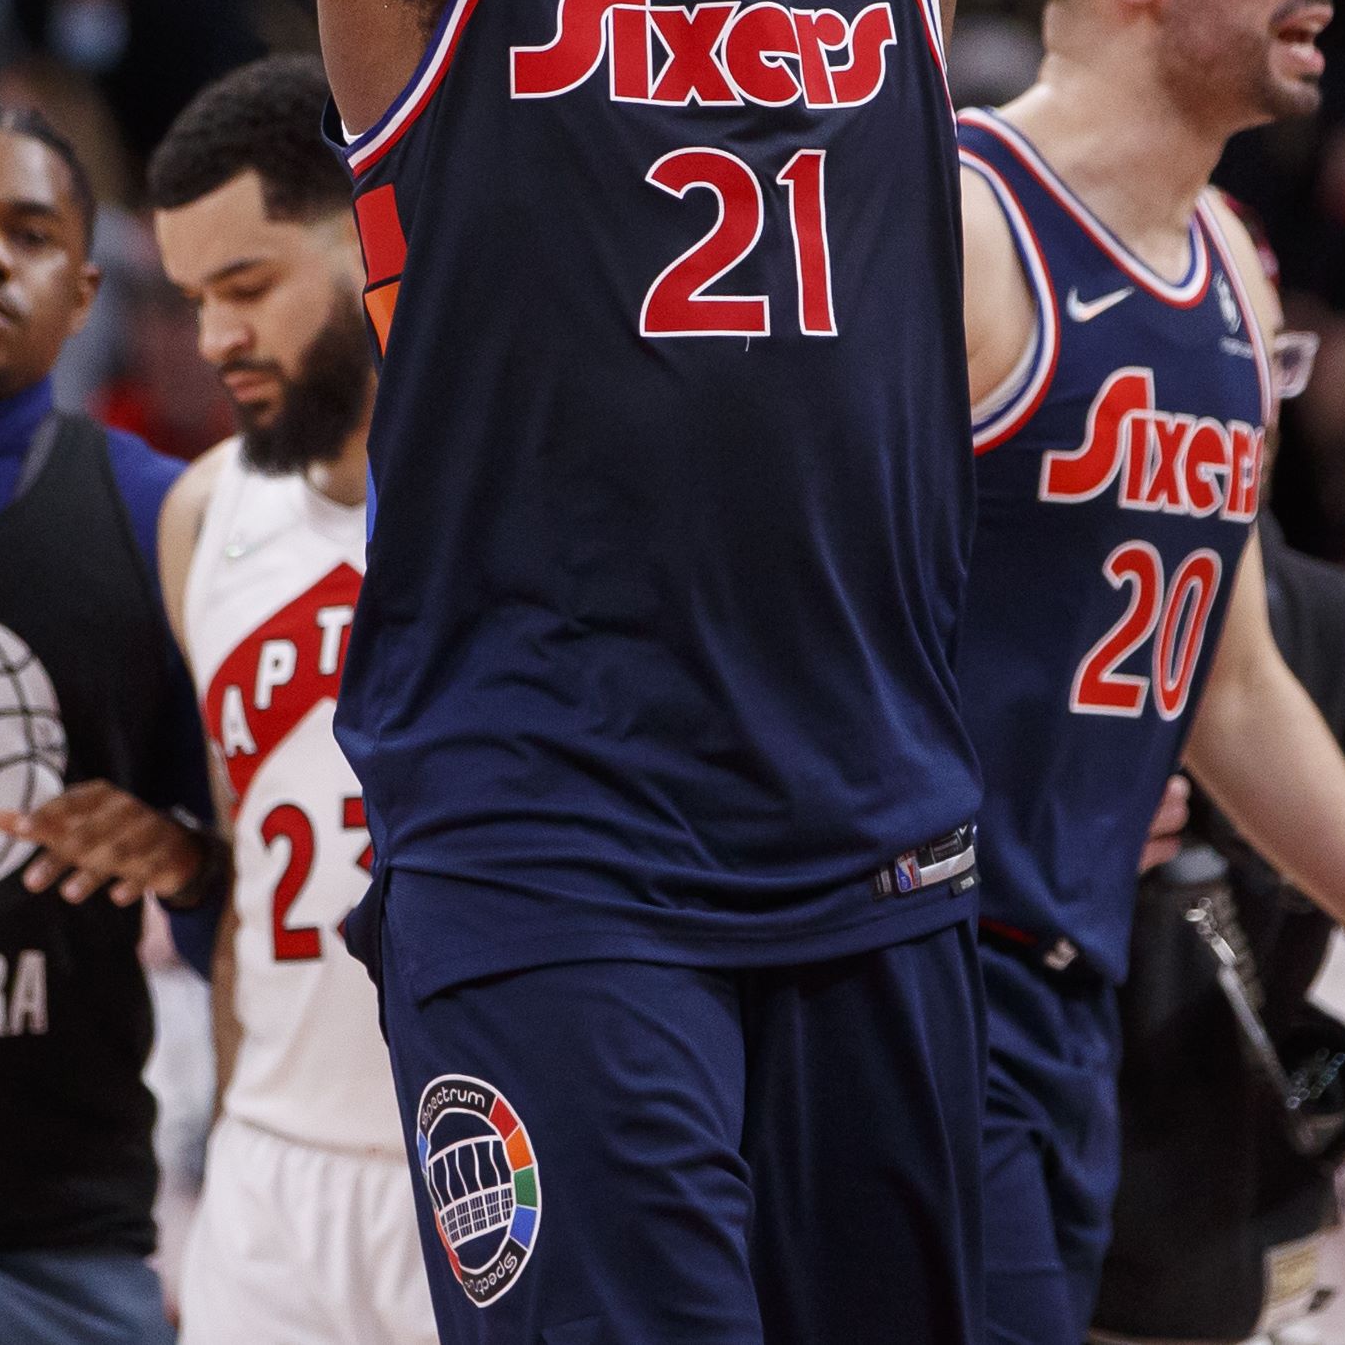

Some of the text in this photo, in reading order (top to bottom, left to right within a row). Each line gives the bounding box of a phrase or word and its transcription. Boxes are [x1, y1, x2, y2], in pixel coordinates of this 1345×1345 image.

[639, 147, 838, 337] 21
[1039, 366, 1265, 523] Sixer
[1069, 539, 1223, 721] 20
